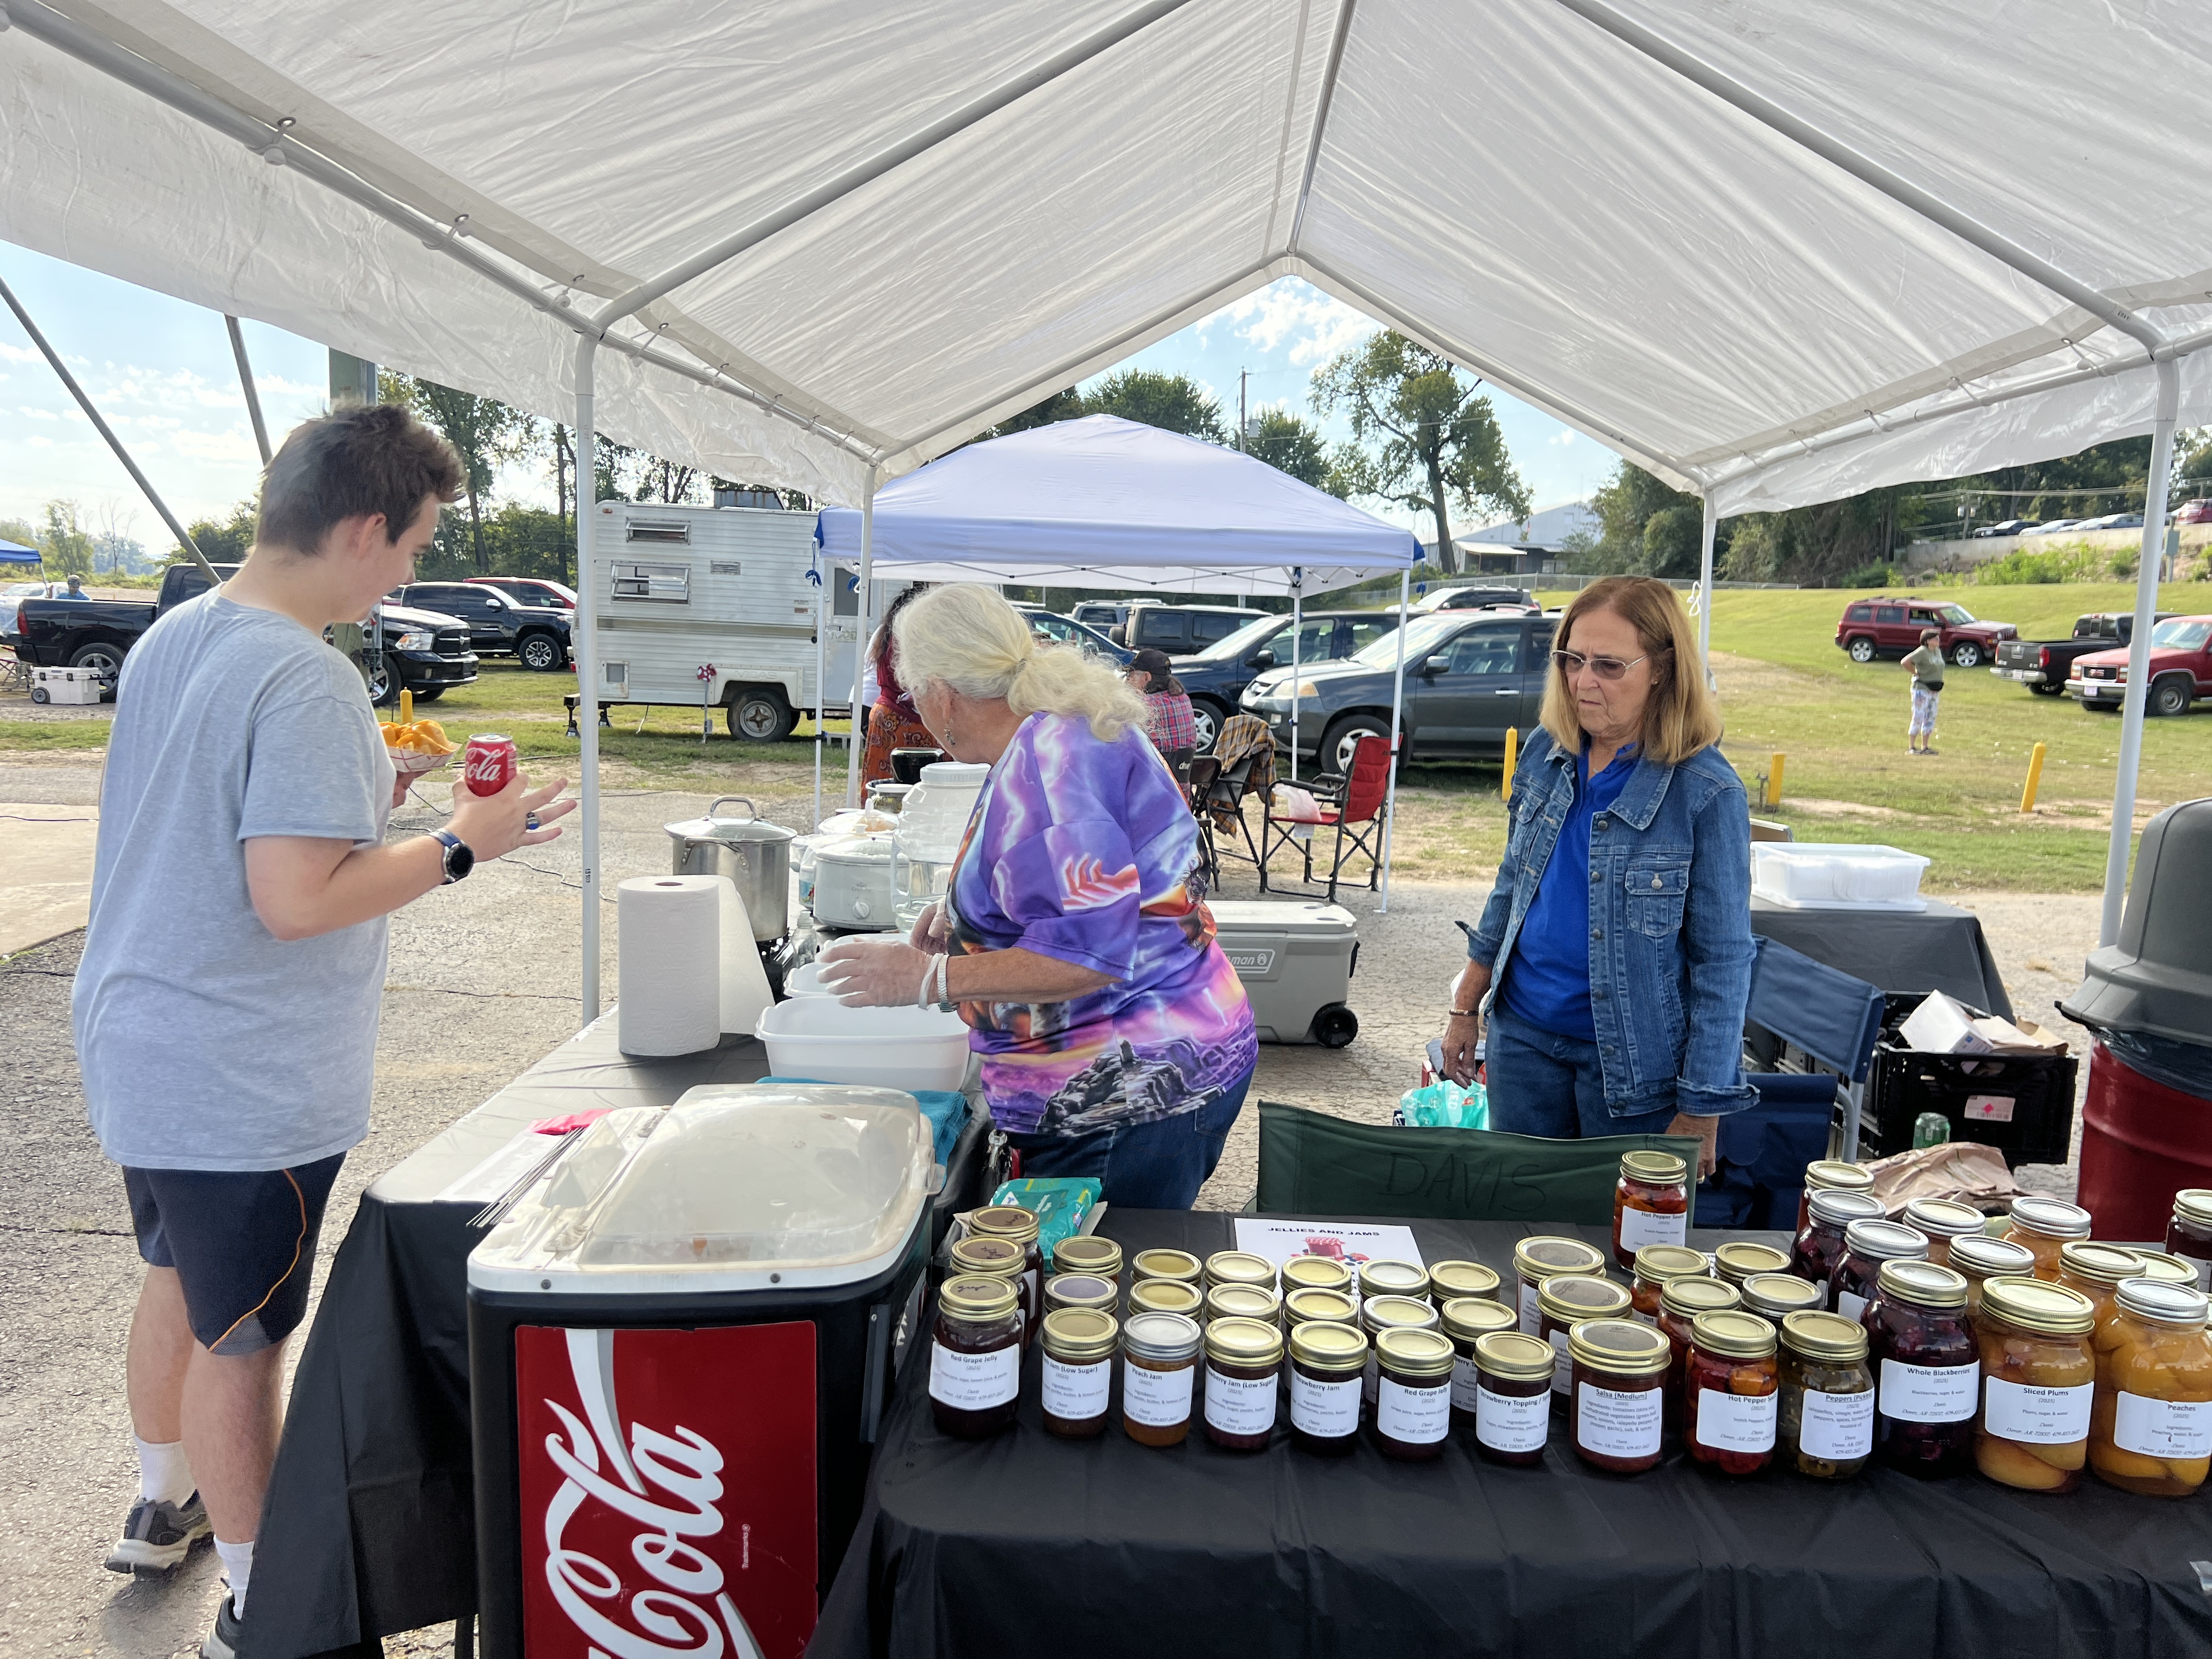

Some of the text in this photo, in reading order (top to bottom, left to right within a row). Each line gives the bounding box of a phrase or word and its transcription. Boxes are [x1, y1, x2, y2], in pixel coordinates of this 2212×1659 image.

[1378, 1152, 1546, 1212] DAVIS
[951, 1353, 961, 1362] Red
[1078, 1365, 1097, 1374] Sugar)
[1132, 1367, 1148, 1378] Peach
[1907, 1368, 1931, 1376] Whole
[1296, 1374, 1325, 1391] Strawberry
[1596, 1389, 1612, 1397] Salsa
[2023, 1387, 2045, 1396] Sliced
[1480, 1390, 1511, 1407] Strawberry
